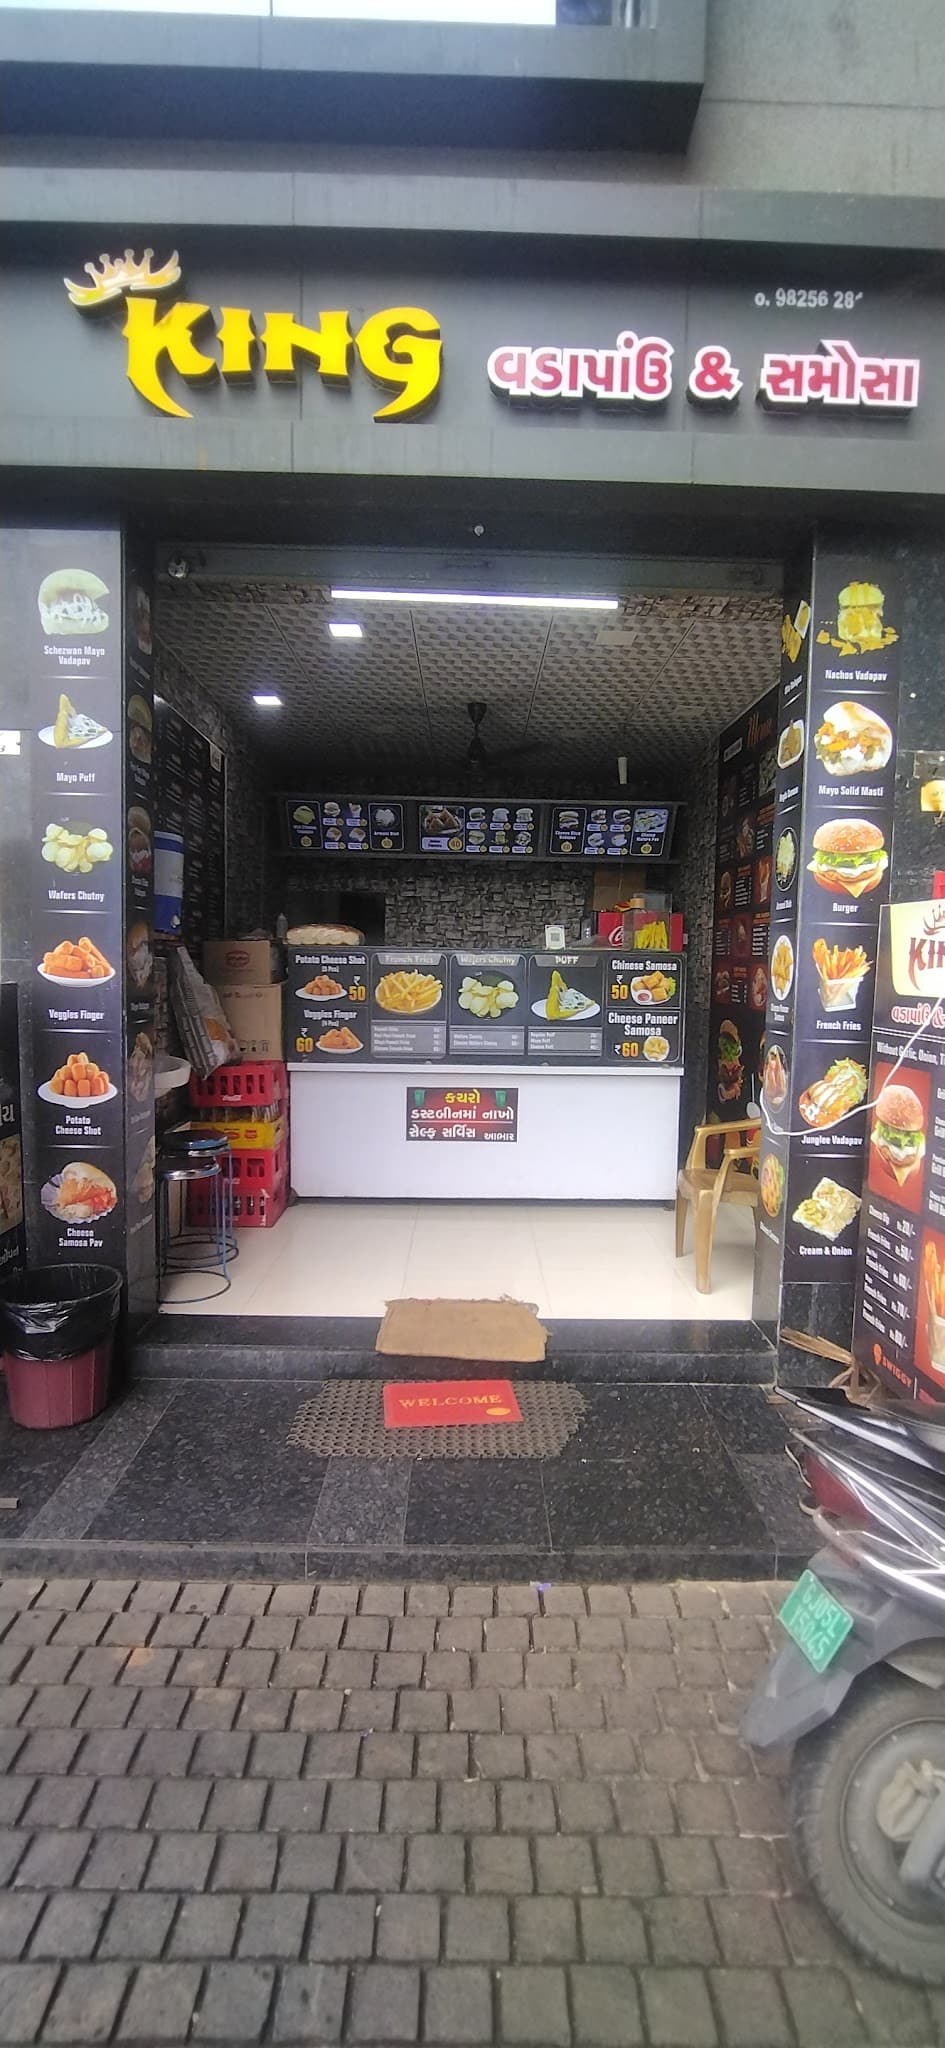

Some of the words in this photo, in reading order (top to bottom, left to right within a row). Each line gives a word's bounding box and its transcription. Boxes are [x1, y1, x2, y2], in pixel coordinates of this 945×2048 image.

[775, 287, 829, 308] 98256
[123, 297, 443, 421] KING
[689, 347, 741, 400] &
[759, 340, 921, 406] સમોસા
[43, 644, 82, 656] Schezwan
[84, 645, 105, 658] Mayo
[58, 654, 91, 666] Vadapav
[825, 668, 853, 681] Nachos
[855, 669, 887, 682] Vadapav
[56, 771, 77, 783] Mayo
[79, 772, 96, 783] Puff
[818, 784, 839, 798] Mayo
[840, 784, 859, 797] Solid
[861, 785, 883, 796] Masti
[48, 889, 75, 901] Wafers
[78, 890, 104, 903] Chutny
[833, 902, 858, 914] Burger
[294, 953, 320, 964] Potato
[321, 953, 347, 964] Cheese
[348, 954, 366, 965] Shot
[611, 960, 643, 971] Chinese
[645, 961, 678, 971] Samosa
[348, 986, 366, 1000] 50
[611, 984, 628, 1000] 50
[49, 1008, 78, 1021] Veggies
[80, 1009, 104, 1021] Finger
[304, 1009, 332, 1020] Veggies
[334, 1010, 358, 1020] Finger
[608, 1012, 643, 1024] Cheese
[645, 1013, 678, 1025] Paneer
[624, 1025, 661, 1036] Samosa
[817, 1019, 843, 1031] French
[845, 1020, 861, 1031] Fries
[295, 1037, 314, 1053] 60
[444, 1089, 480, 1103] કચરો
[482, 1106, 514, 1119] નાખો
[66, 1116, 91, 1125] Potato
[55, 1126, 81, 1136] Cheese
[83, 1126, 101, 1136] Shot
[66, 1228, 94, 1238] Cheese
[59, 1238, 87, 1248] Samosa
[88, 1239, 103, 1249] Pav
[799, 1246, 823, 1256] Cream
[825, 1246, 831, 1256] &
[833, 1246, 853, 1256] Onion
[398, 1394, 502, 1408] WELCOME
